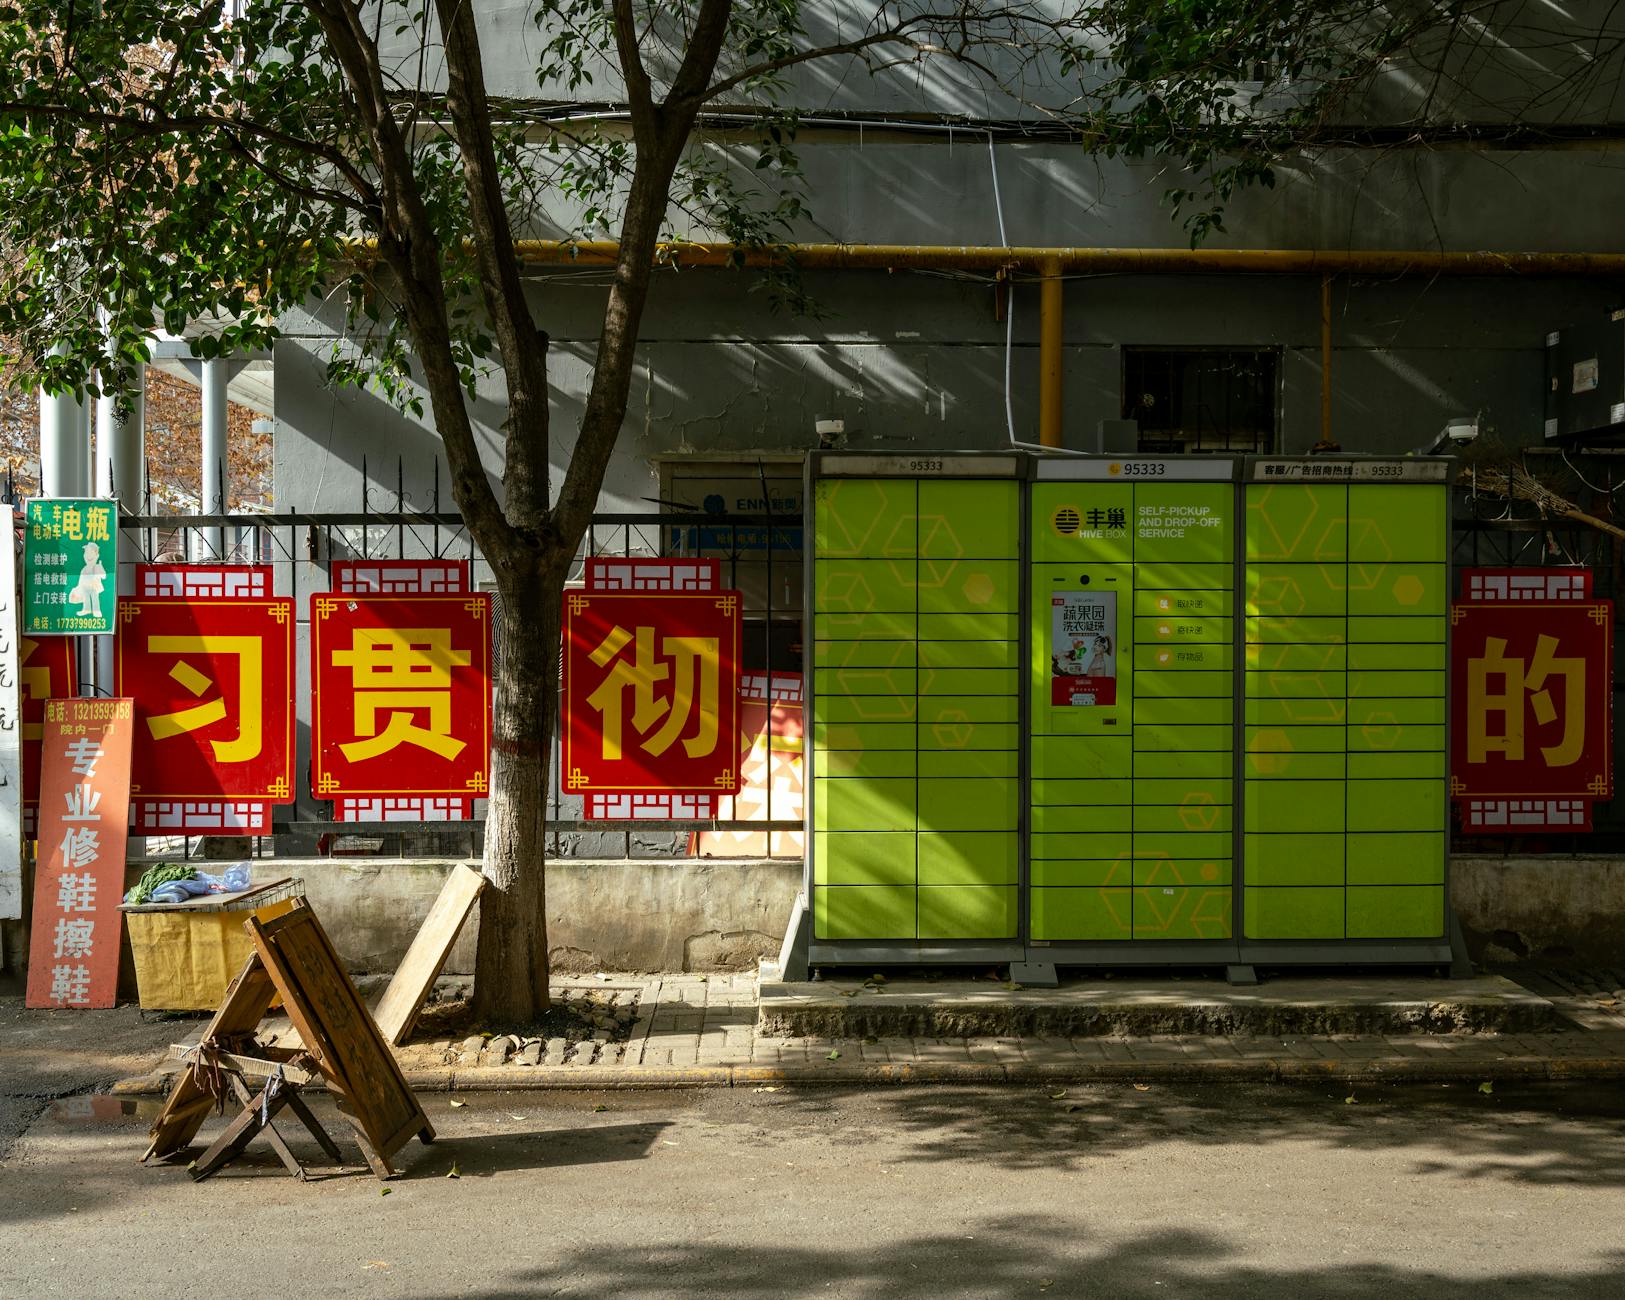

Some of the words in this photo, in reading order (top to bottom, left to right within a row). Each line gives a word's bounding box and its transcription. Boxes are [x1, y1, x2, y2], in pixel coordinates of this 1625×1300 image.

[910, 461, 943, 471] 95333
[1124, 463, 1165, 475] 95333
[1371, 466, 1403, 476] 95333
[33, 504, 62, 521] 汽车
[1086, 508, 1127, 529] 丰巢
[1138, 506, 1210, 516] SELF-PICKUP
[62, 506, 110, 541] 电瓶
[1139, 517, 1162, 527] AND
[1164, 517, 1221, 527] DROP-OFF
[33, 523, 62, 540] 电动车
[1079, 529, 1103, 539] HIVE
[1105, 529, 1127, 539] BOX
[1139, 528, 1184, 538] SERVICE
[33, 591, 67, 605] 上门安装
[1063, 605, 1105, 620] 蔬果园
[146, 636, 262, 762] 习
[332, 628, 471, 763] 贯
[586, 625, 719, 760] 彻
[1468, 634, 1586, 767] 的
